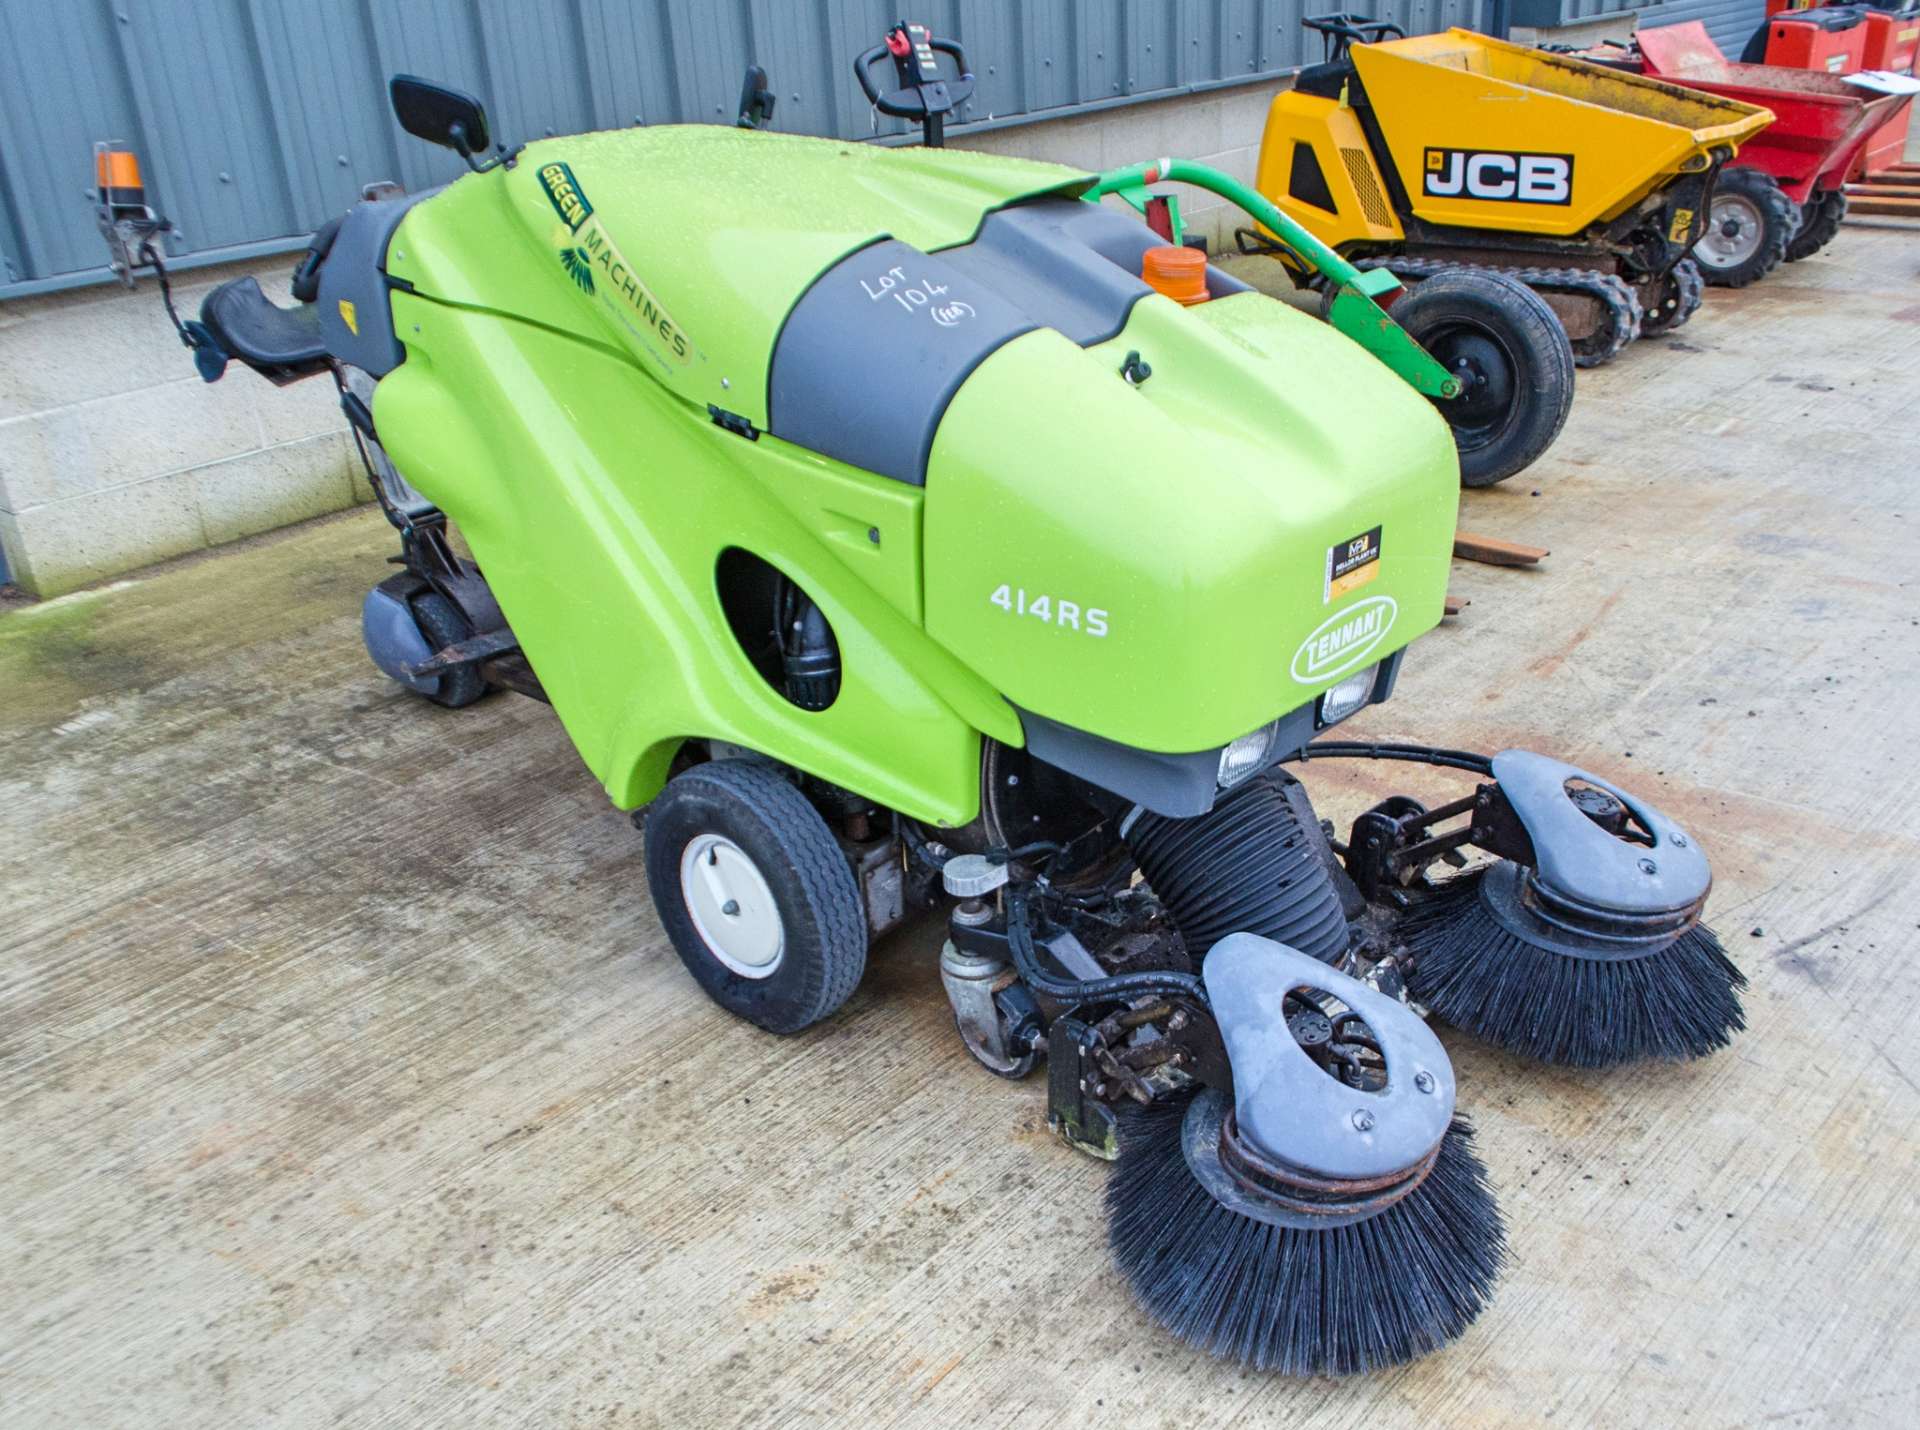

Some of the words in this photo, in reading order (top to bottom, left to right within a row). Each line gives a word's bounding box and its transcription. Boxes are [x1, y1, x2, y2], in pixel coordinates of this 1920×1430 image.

[1426, 152, 1569, 201] JCB
[542, 164, 587, 227] GREEN
[583, 227, 687, 357] MACHINES
[860, 266, 906, 300] LOT
[893, 279, 948, 313] 104
[990, 584, 1109, 637] 414RS
[1306, 604, 1387, 673] TENNANT
